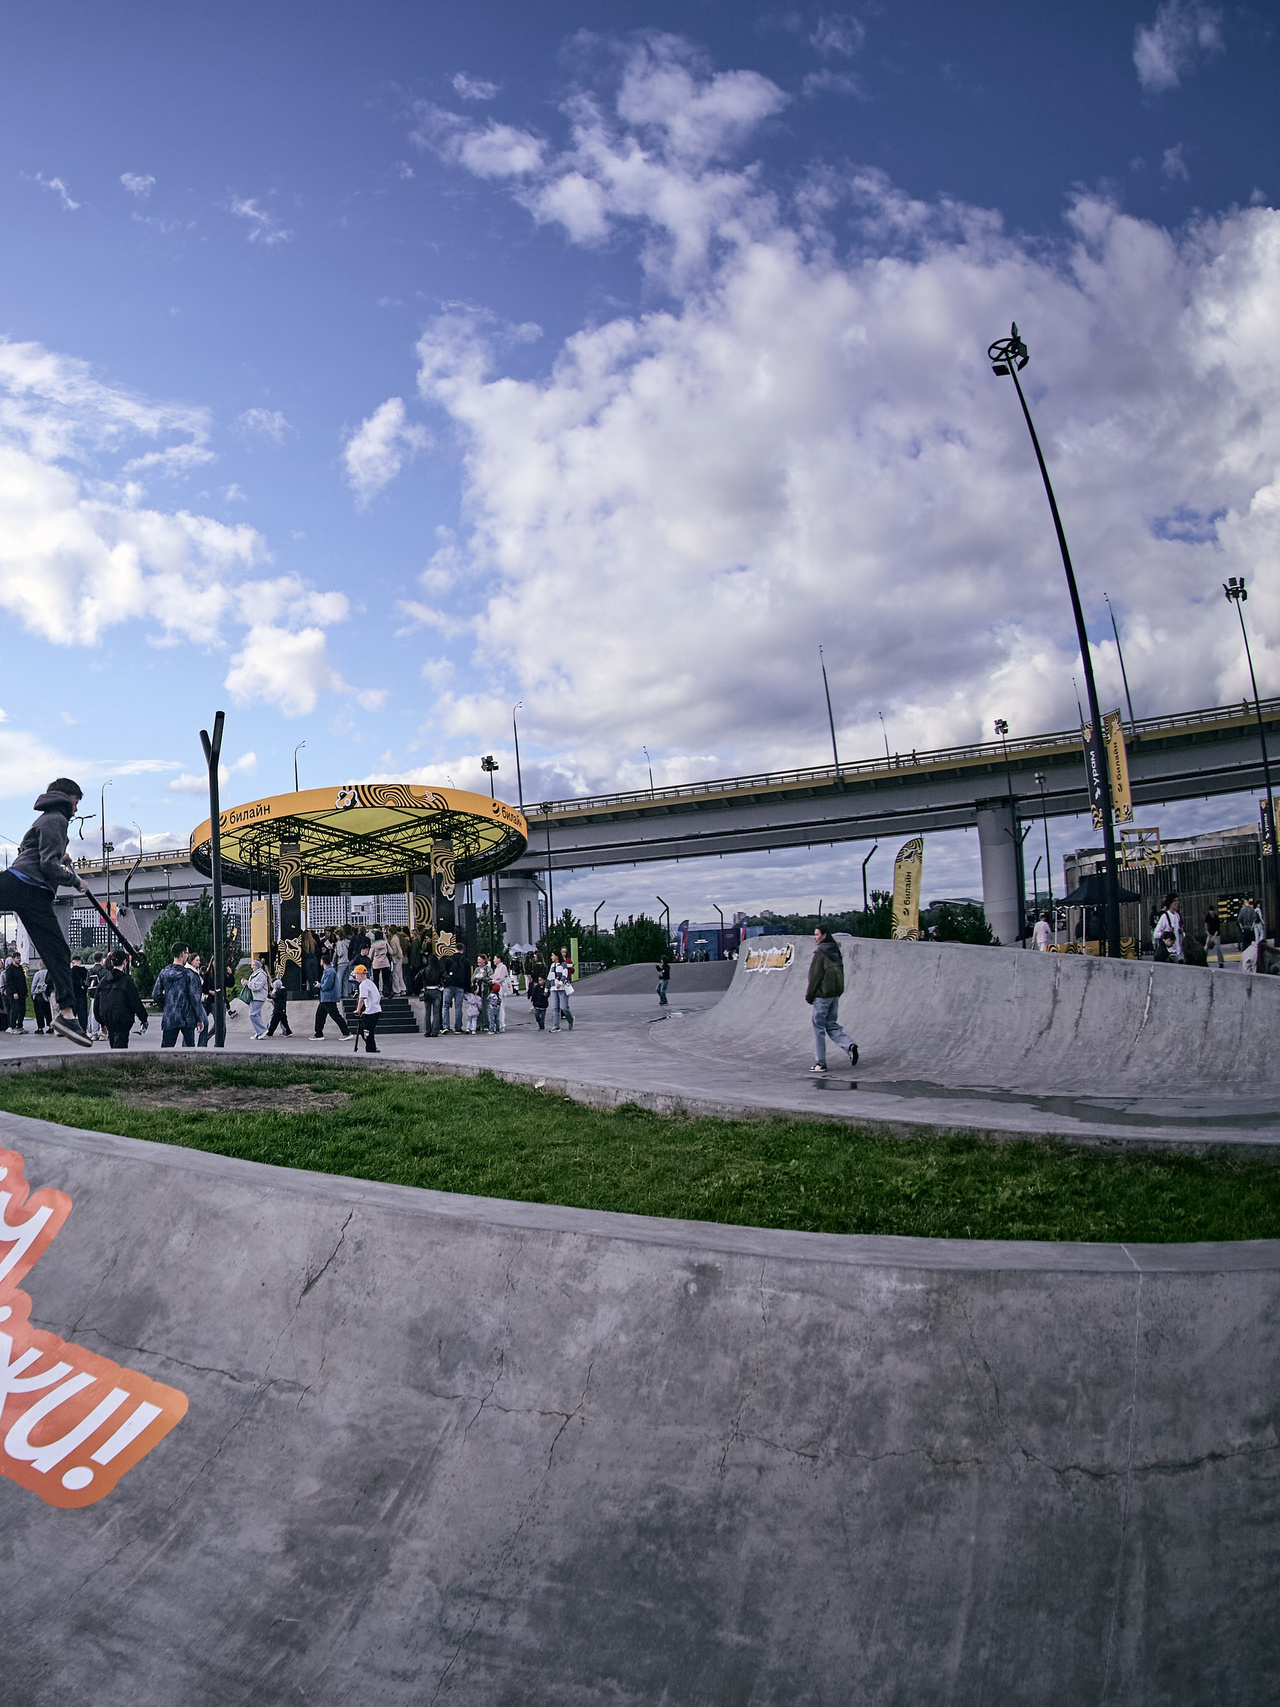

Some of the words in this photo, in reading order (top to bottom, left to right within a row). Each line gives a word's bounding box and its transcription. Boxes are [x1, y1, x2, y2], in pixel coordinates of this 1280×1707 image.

[1113, 741, 1122, 781] билайн
[229, 803, 271, 824] билайн
[903, 871, 912, 905] билайн
